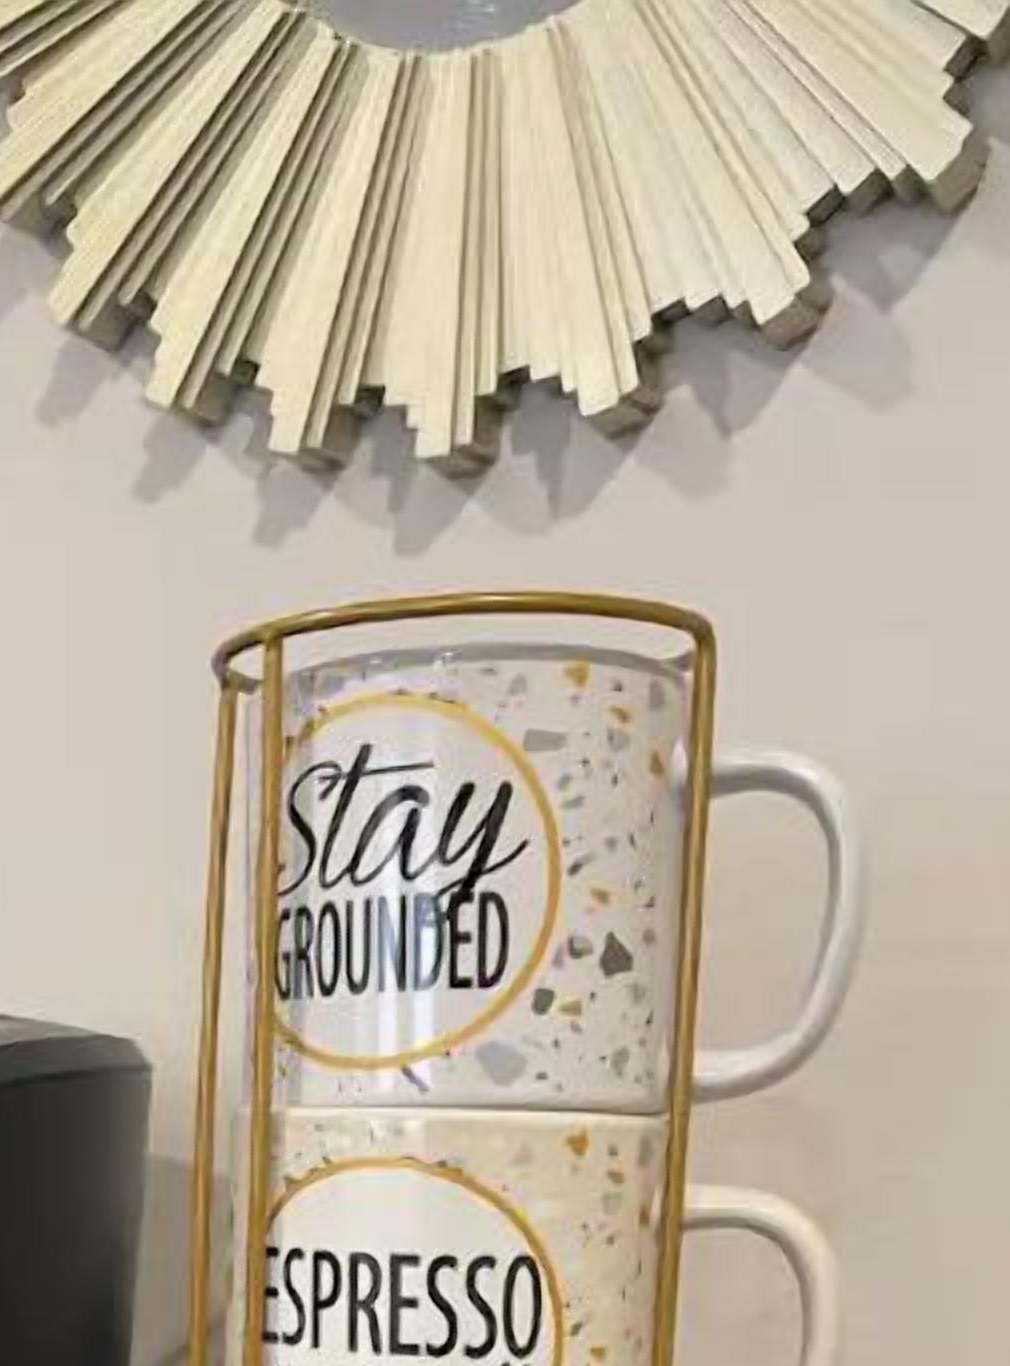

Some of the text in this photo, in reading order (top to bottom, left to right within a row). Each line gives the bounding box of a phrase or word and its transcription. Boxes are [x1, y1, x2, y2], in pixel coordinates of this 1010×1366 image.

[277, 743, 530, 900] Stay
[274, 891, 510, 1001] GROUNDED
[261, 1247, 542, 1359] ESPRESSO
